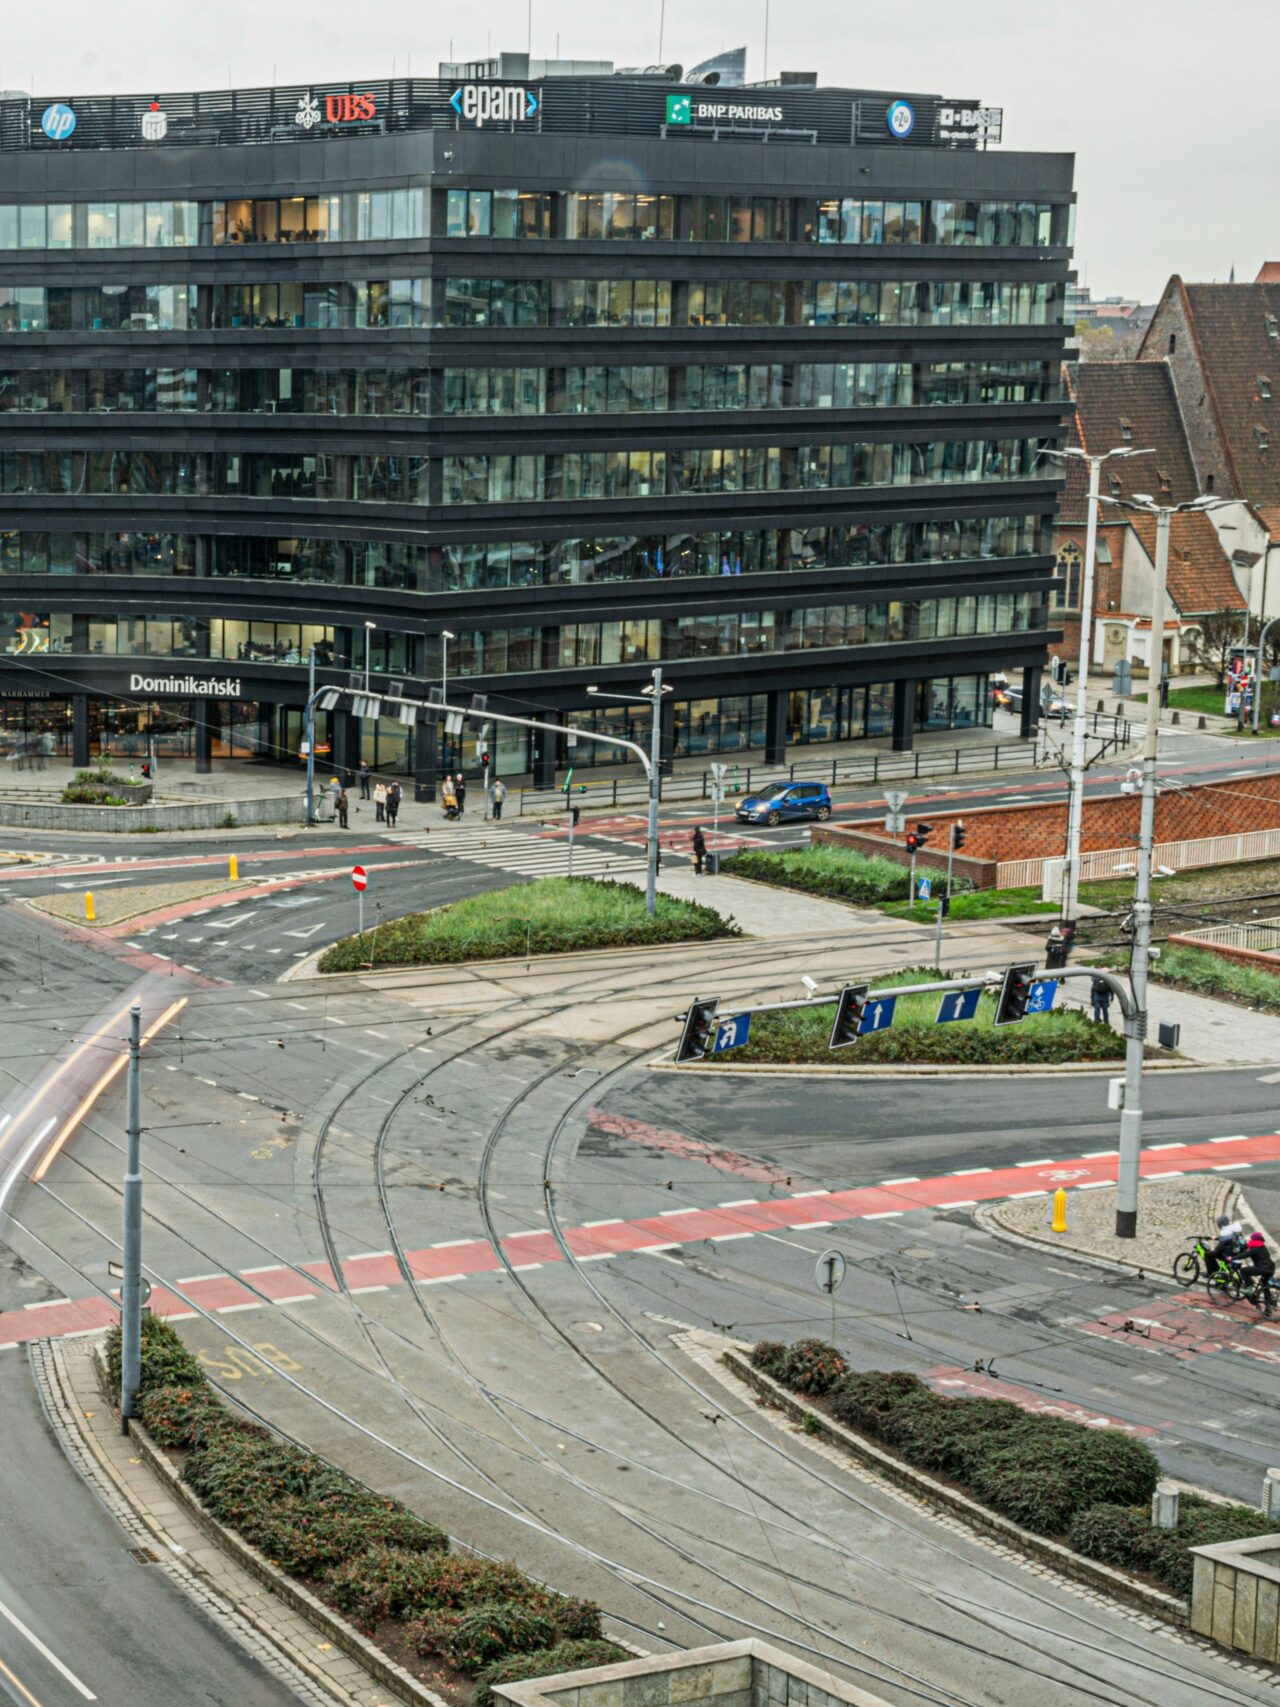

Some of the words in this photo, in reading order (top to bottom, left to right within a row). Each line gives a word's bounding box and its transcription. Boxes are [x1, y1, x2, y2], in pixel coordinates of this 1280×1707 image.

[46, 102, 73, 139] hp
[324, 92, 377, 122] UBS
[462, 85, 526, 127] epam
[698, 104, 727, 118] BNP
[728, 106, 783, 121] PARIBAS
[893, 111, 910, 127] PZU
[130, 674, 241, 697] Dominikański
[198, 1342, 304, 1380] BUS
